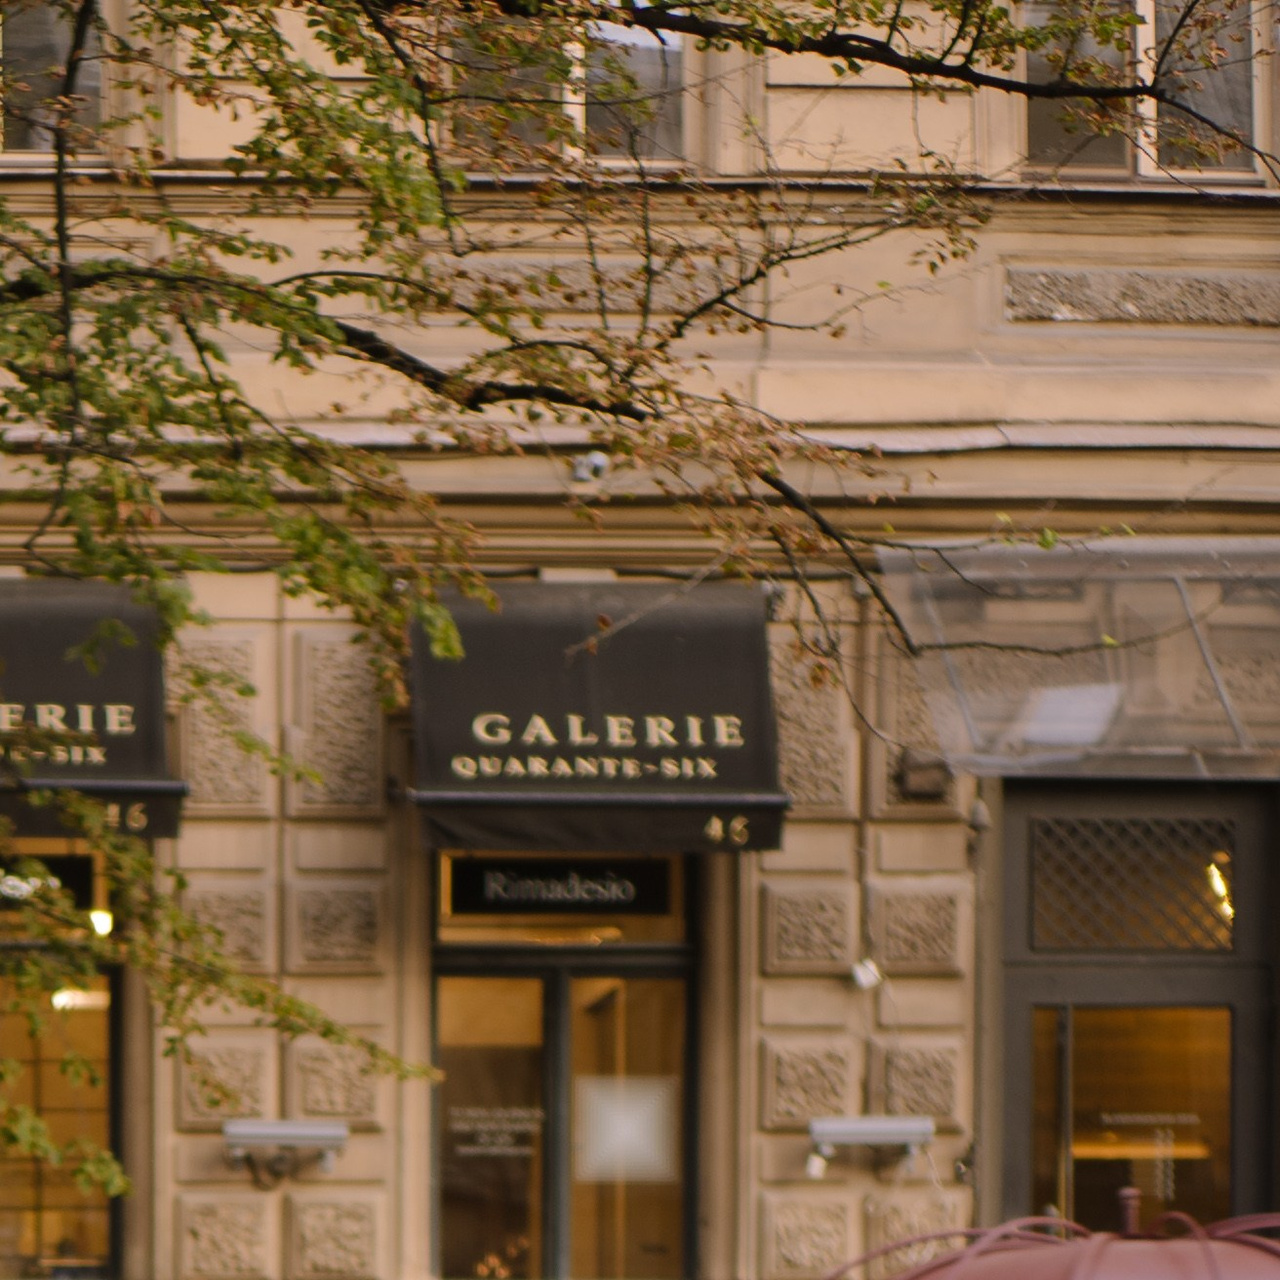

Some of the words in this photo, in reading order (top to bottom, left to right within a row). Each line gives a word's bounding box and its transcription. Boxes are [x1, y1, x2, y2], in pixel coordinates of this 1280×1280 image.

[471, 713, 745, 747] GALERIE
[451, 755, 718, 780] QUARANTE-SIX
[704, 815, 749, 845] 46
[484, 871, 637, 901] Rimadesio
